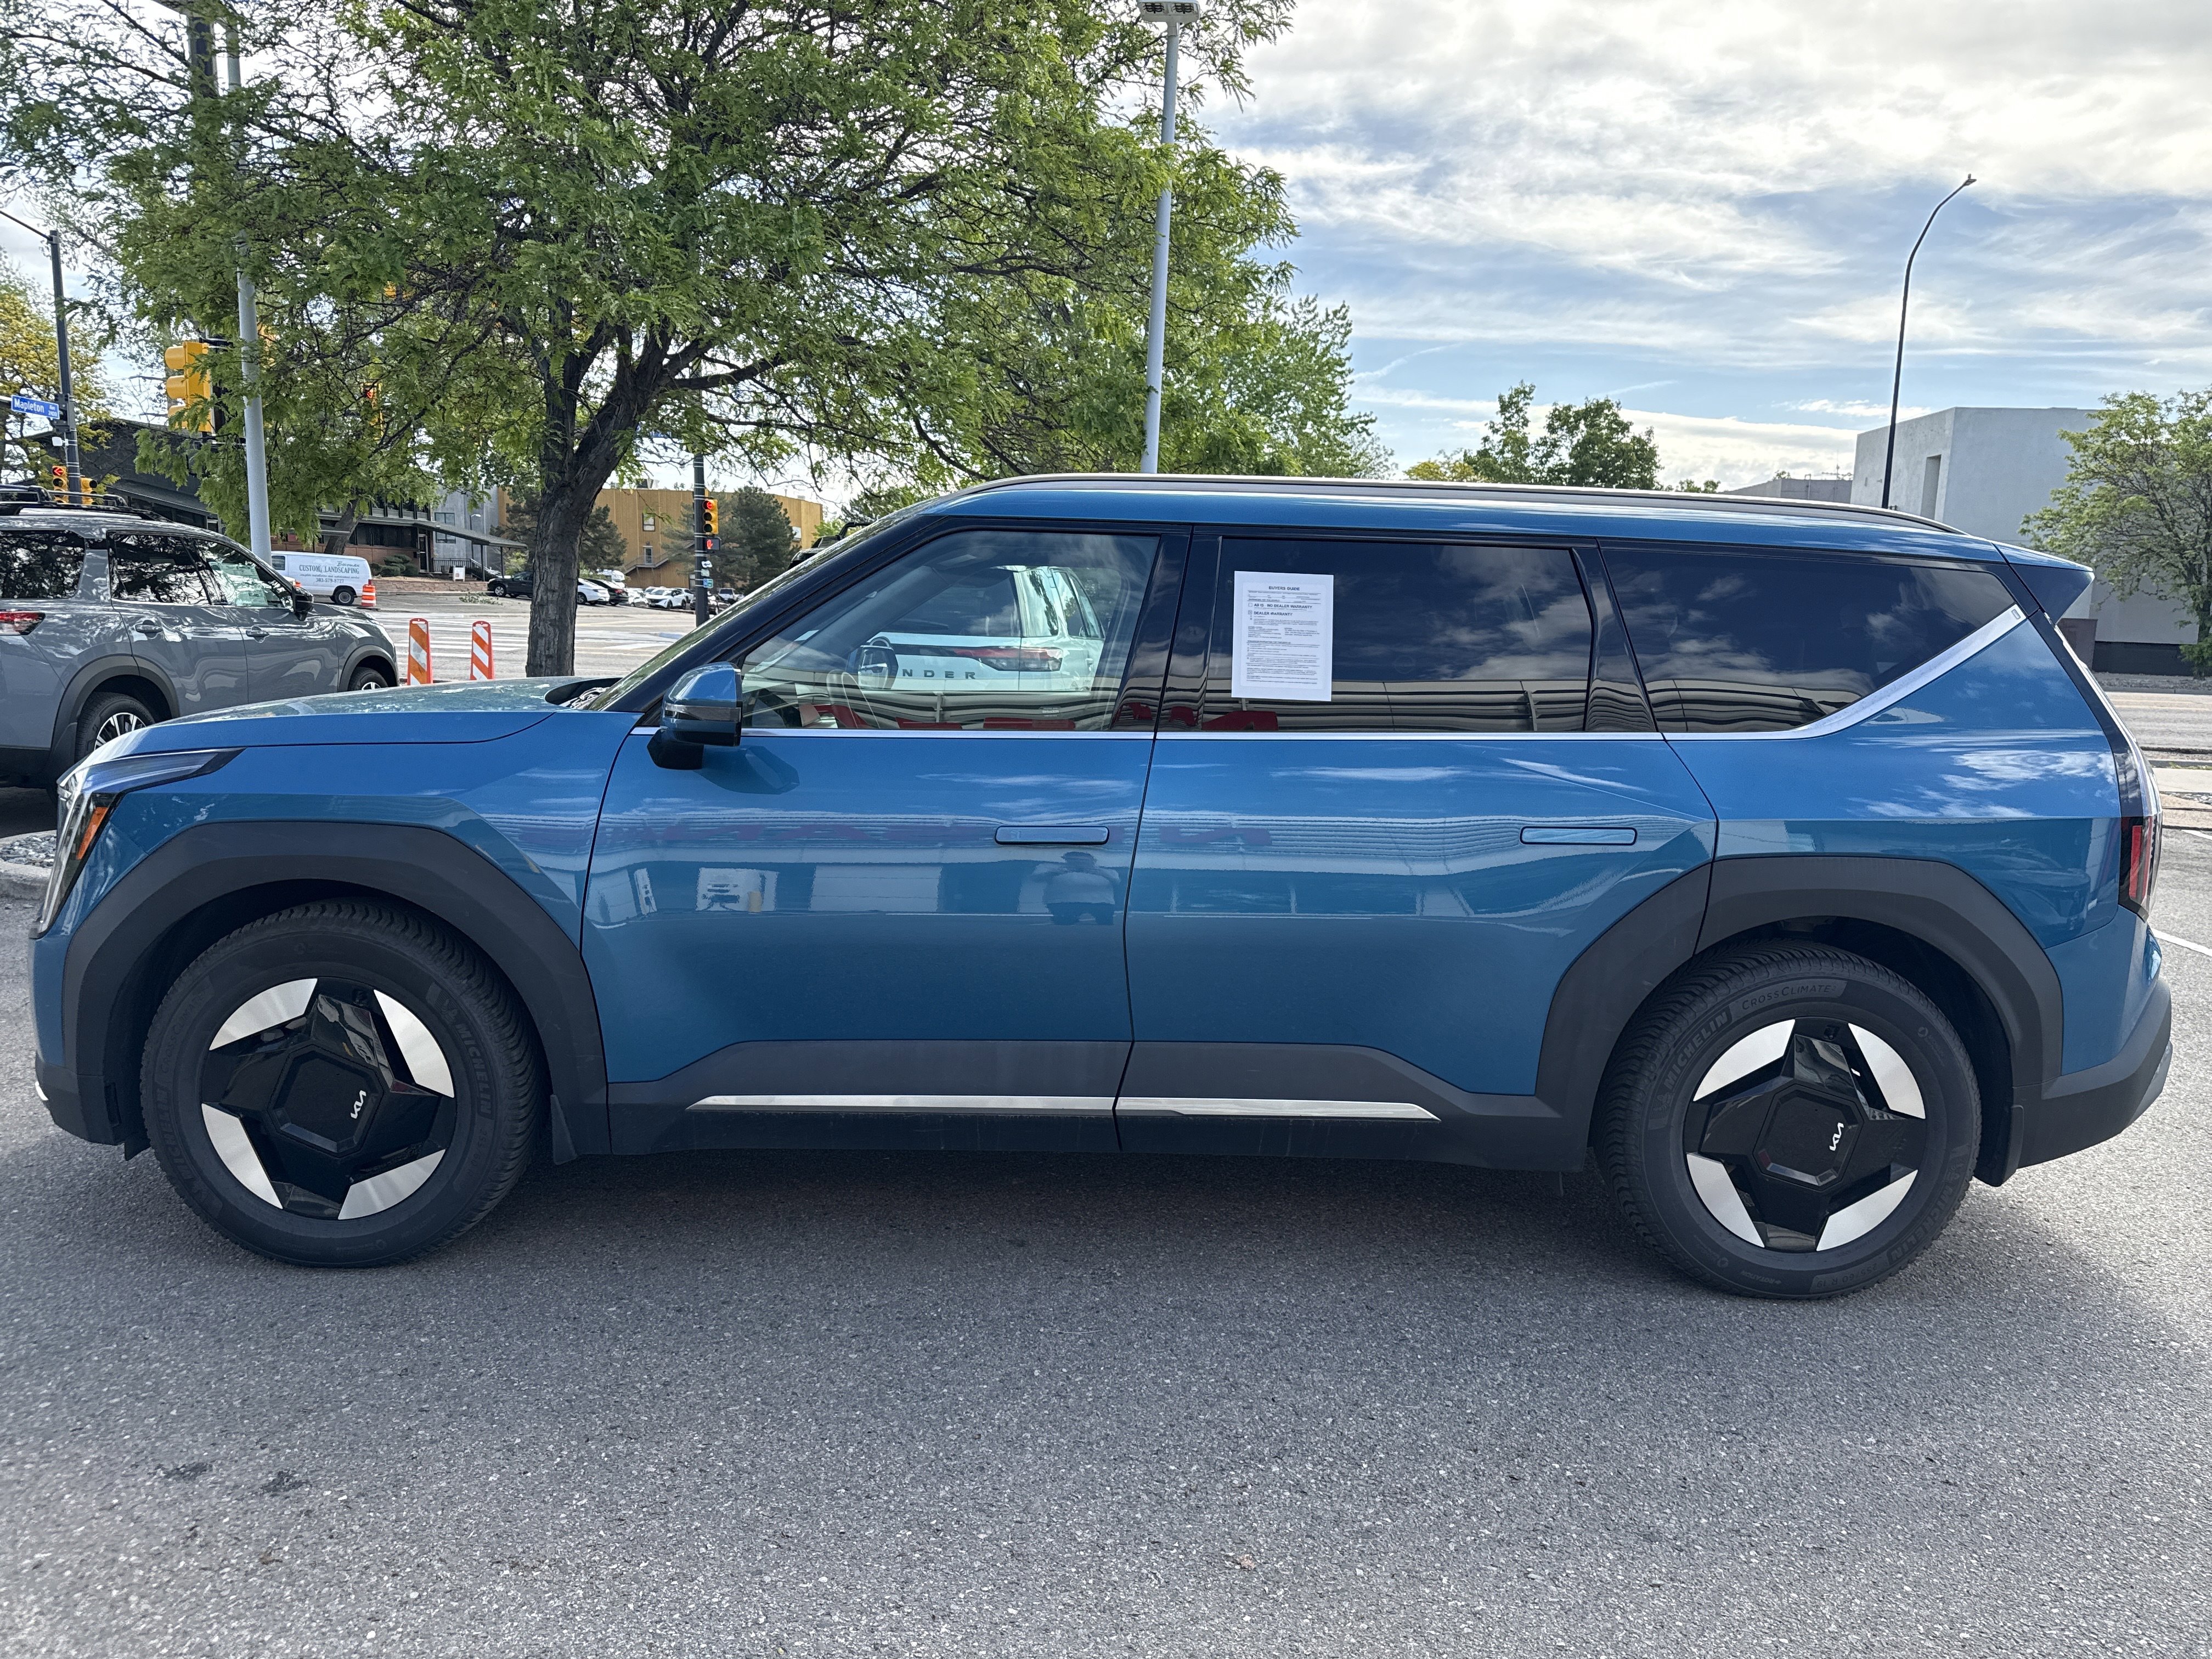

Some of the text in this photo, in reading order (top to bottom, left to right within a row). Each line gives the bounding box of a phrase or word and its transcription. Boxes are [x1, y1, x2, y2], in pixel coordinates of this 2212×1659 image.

[14, 398, 44, 413] Mapleton
[457, 1022, 493, 1115] MICHELIN
[1664, 1012, 1730, 1091] MICHELIN
[1891, 1185, 1954, 1261] MICHELIN
[1831, 1277, 1838, 1285] R
